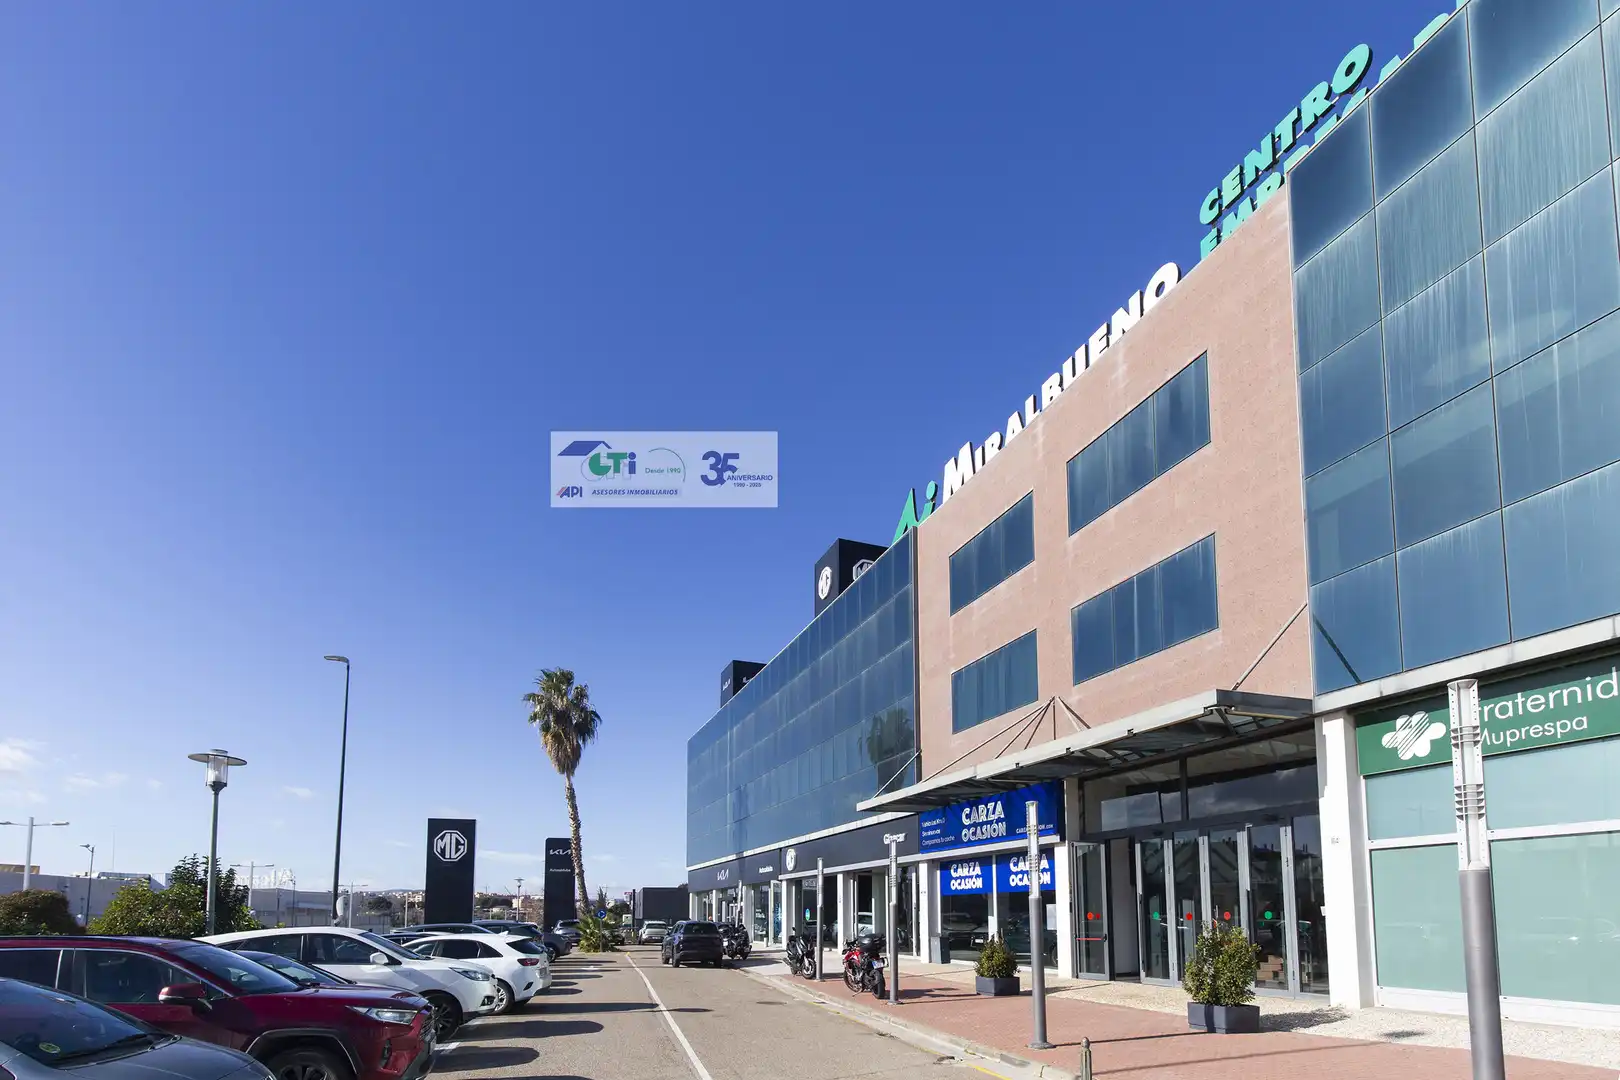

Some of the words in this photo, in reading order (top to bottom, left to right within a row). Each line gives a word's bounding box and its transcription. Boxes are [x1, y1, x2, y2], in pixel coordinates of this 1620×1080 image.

[1200, 43, 1372, 225] CENTRO
[1478, 666, 1619, 722] raternid
[962, 801, 1005, 825] CARZA
[961, 820, 1007, 842] OCASIÓN
[436, 832, 465, 859] MG
[950, 862, 982, 878] CARZA
[1009, 854, 1050, 872] CAA
[950, 875, 983, 891] OCASIÓN
